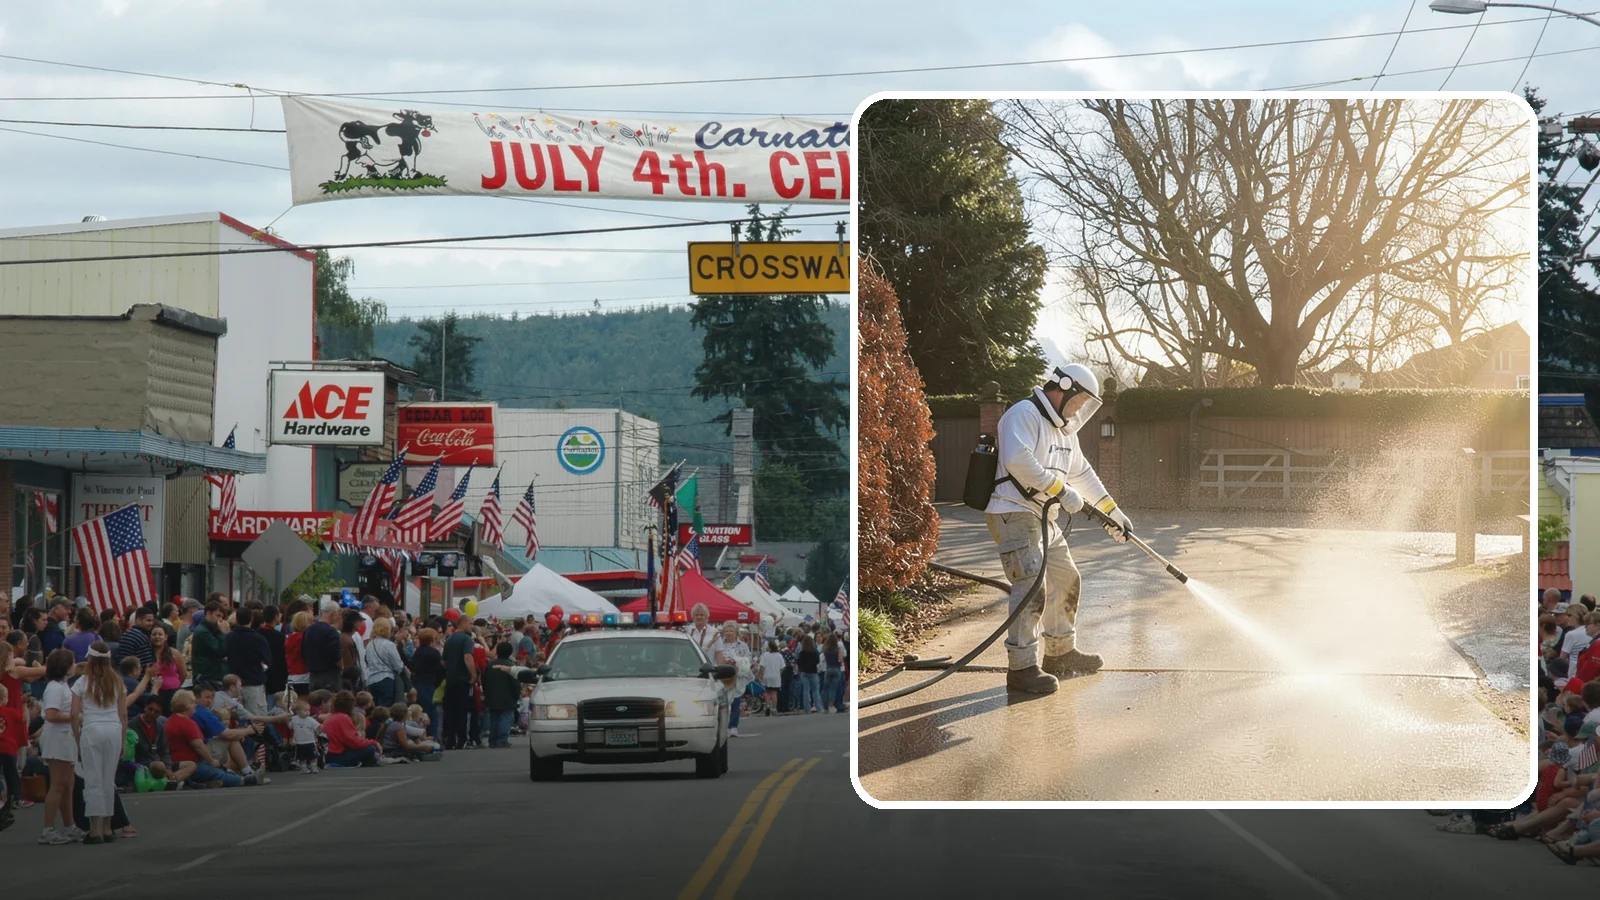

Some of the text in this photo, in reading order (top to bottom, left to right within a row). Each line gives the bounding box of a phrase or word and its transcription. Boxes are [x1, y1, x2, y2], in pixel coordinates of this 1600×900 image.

[695, 121, 850, 150] Carnat
[482, 141, 605, 193] JULY
[632, 150, 746, 198] 4th.
[697, 254, 850, 280] CROSSWA
[282, 380, 374, 420] ACE
[405, 409, 453, 422] CEDAR
[283, 421, 371, 436] Hardware
[416, 428, 477, 447] Coca-Cola
[96, 485, 124, 495] Vincent
[126, 486, 136, 495] de
[137, 486, 155, 495] Paul
[688, 526, 741, 535] CRNATION
[699, 535, 730, 543] GLASS
